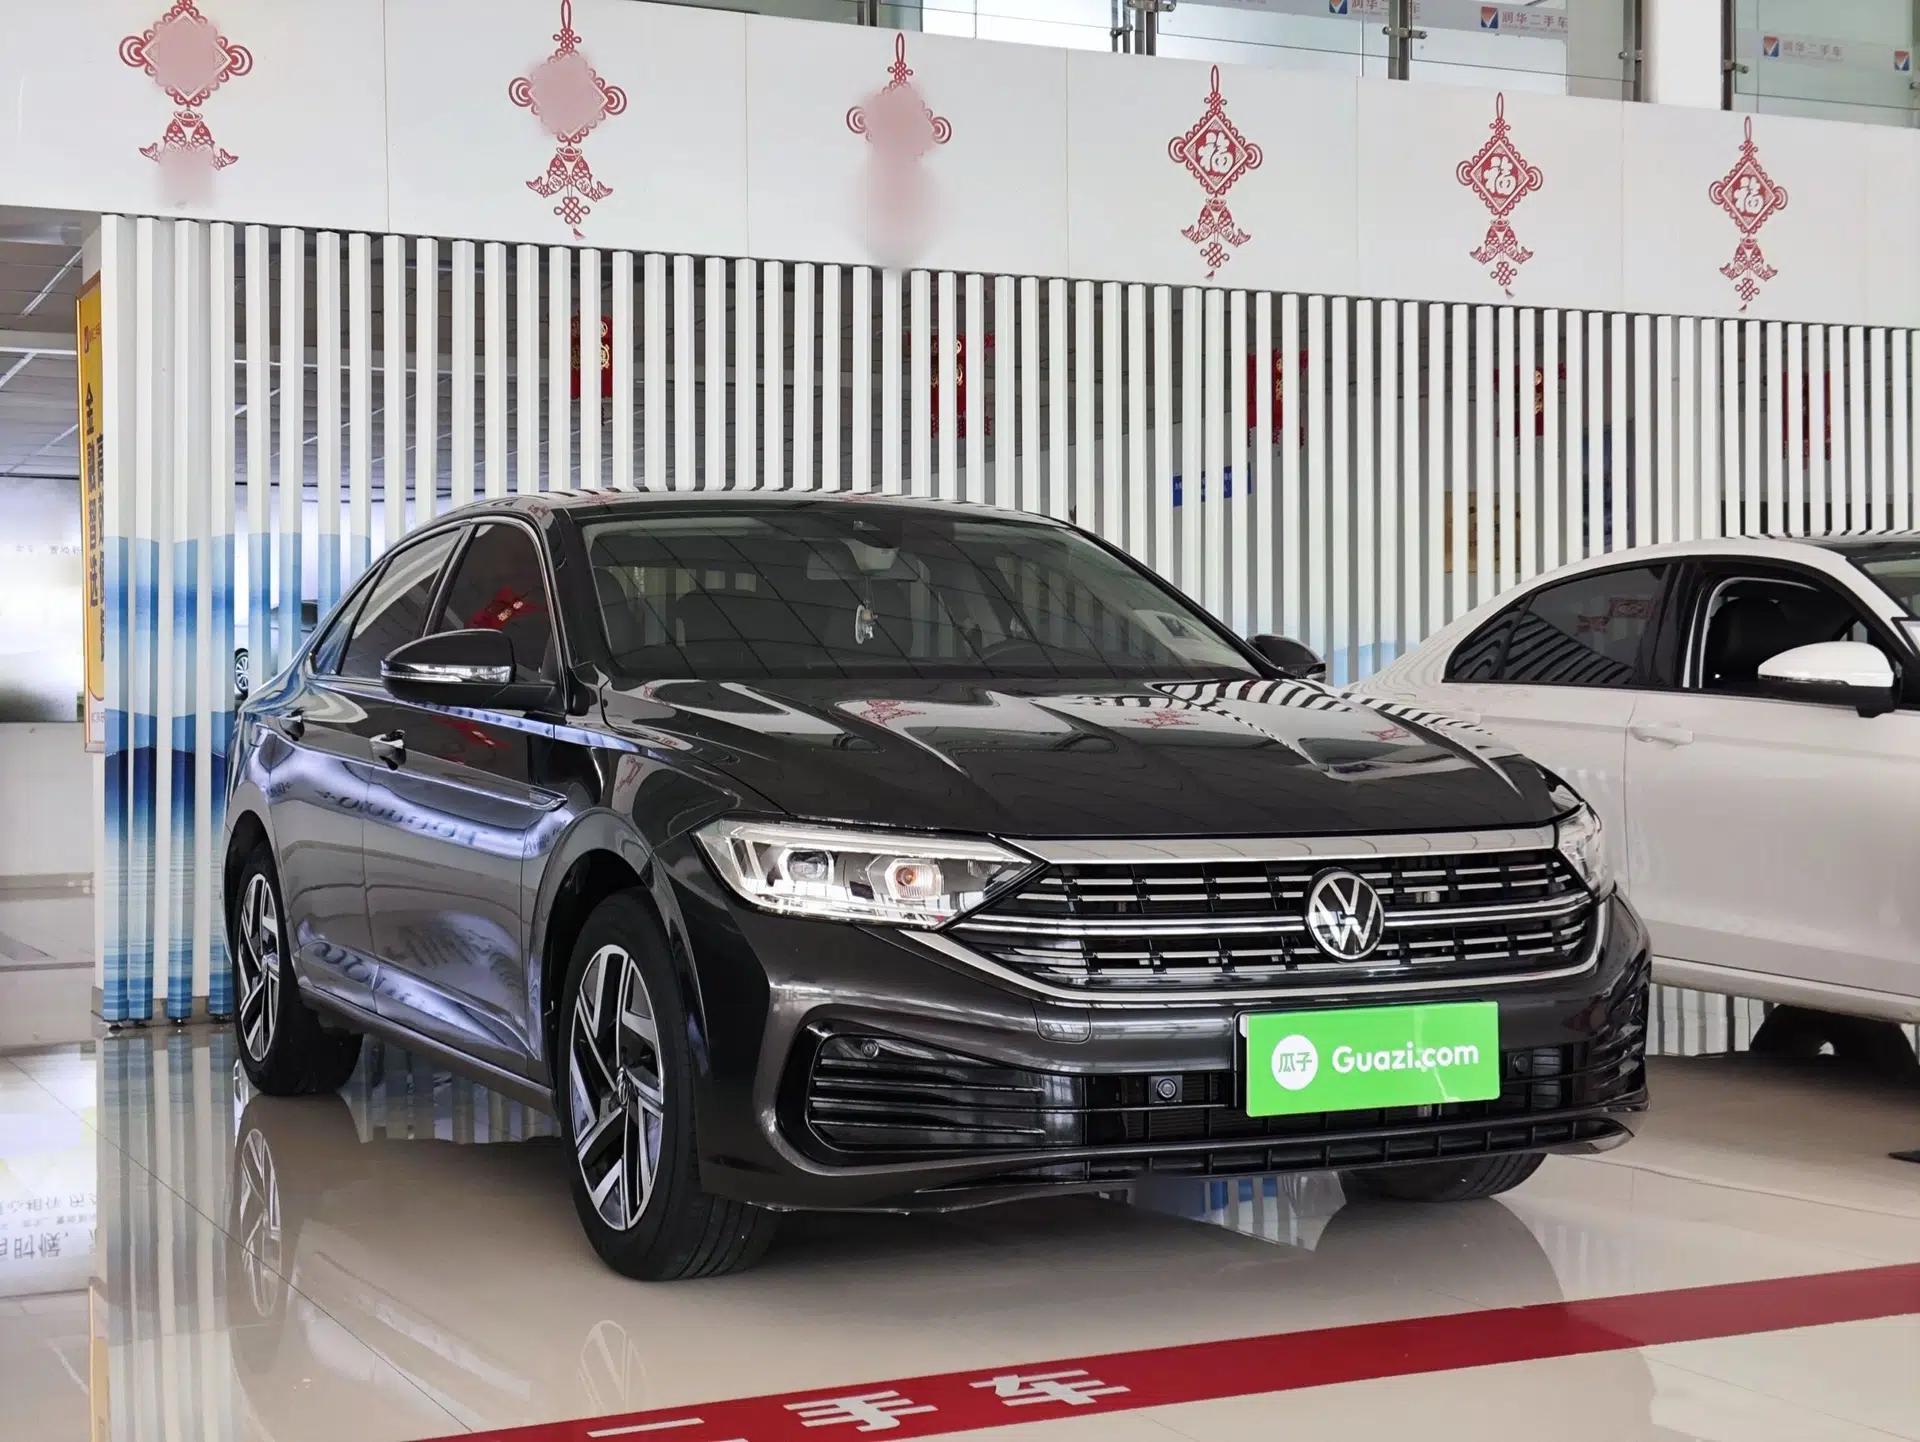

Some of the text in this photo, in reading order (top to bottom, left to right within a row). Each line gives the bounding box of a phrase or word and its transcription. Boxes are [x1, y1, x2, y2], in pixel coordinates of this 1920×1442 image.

[1198, 131, 1234, 174] 福
[1483, 156, 1517, 196] 福
[1733, 176, 1764, 214] 福
[1278, 1051, 1313, 1073] 瓜子
[1332, 1041, 1479, 1073] Guazi.com
